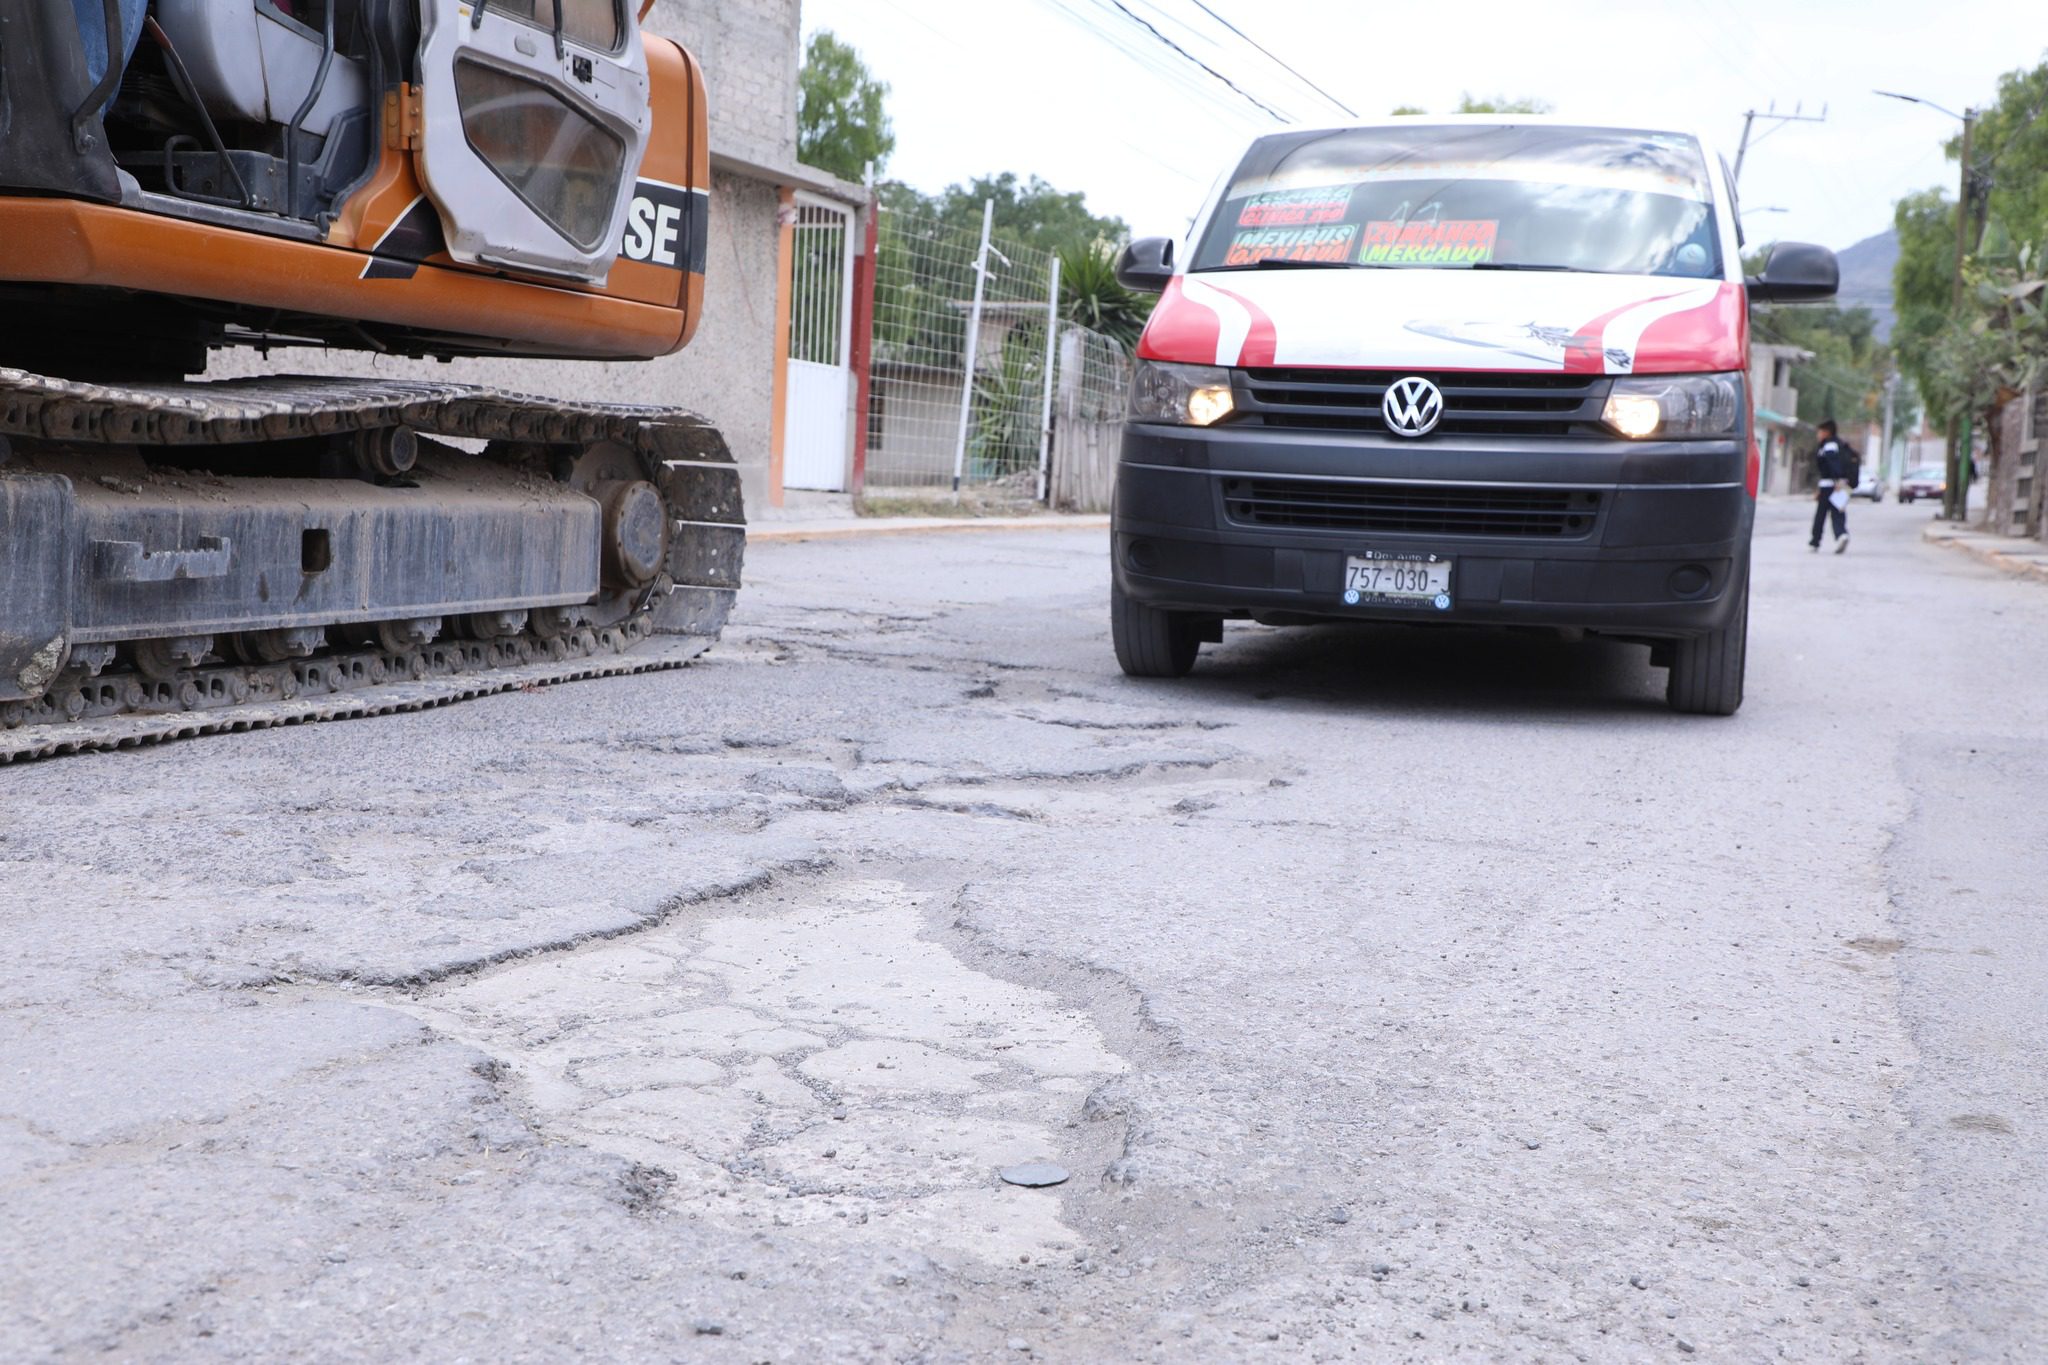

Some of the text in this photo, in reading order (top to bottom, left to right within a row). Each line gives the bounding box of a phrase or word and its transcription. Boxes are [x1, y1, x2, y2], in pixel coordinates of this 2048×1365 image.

[618, 196, 681, 265] SE
[1236, 227, 1351, 246] MEXIBUS
[1366, 244, 1487, 261] MERCADO
